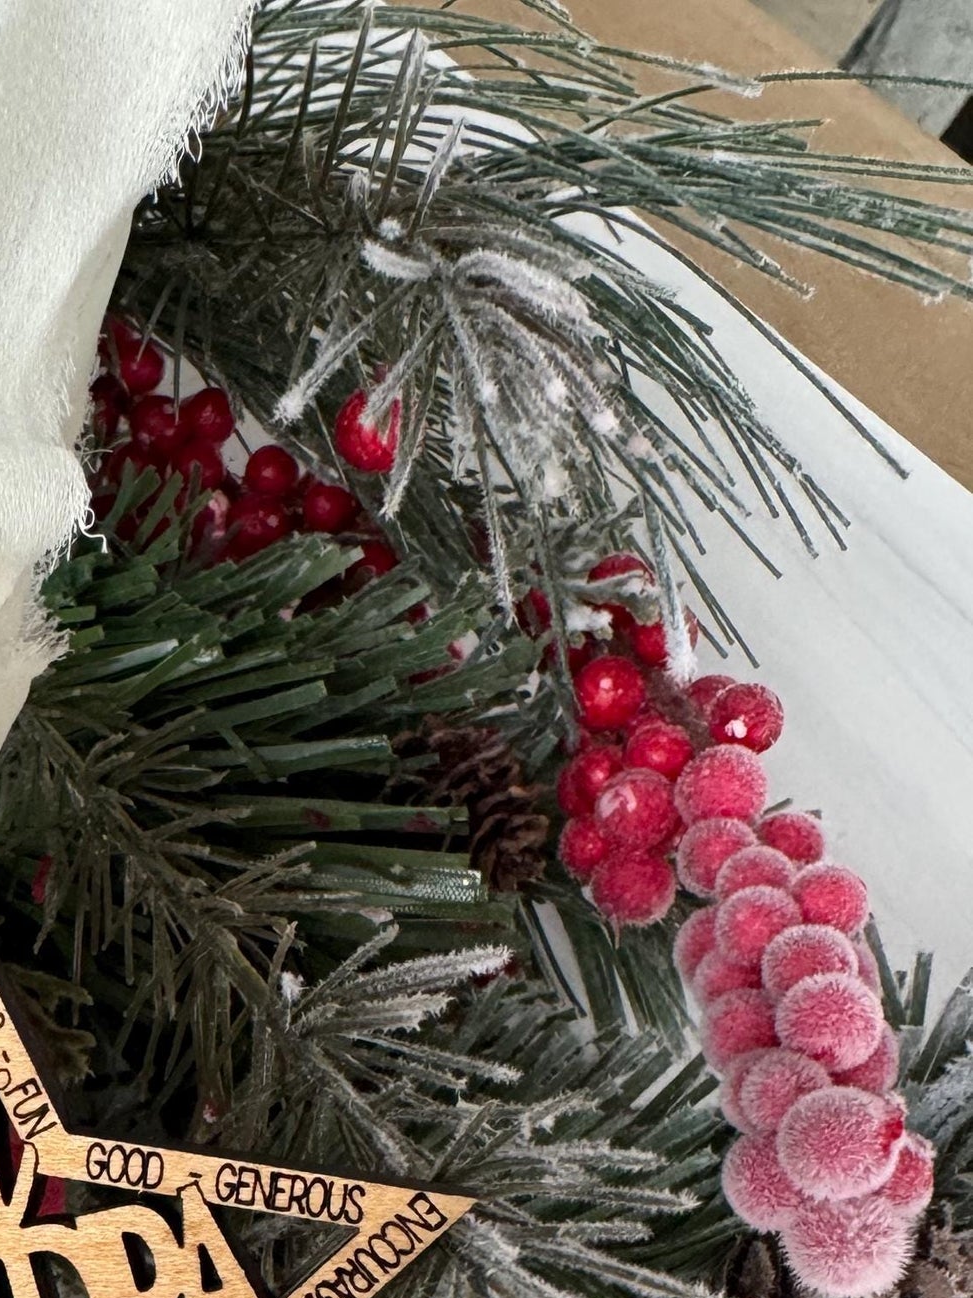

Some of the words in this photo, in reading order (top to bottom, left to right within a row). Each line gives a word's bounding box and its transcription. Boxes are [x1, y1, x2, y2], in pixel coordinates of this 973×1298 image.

[4, 1078, 57, 1140] FUN
[86, 1142, 164, 1189] GOOD
[215, 1163, 366, 1224] GENEROUS
